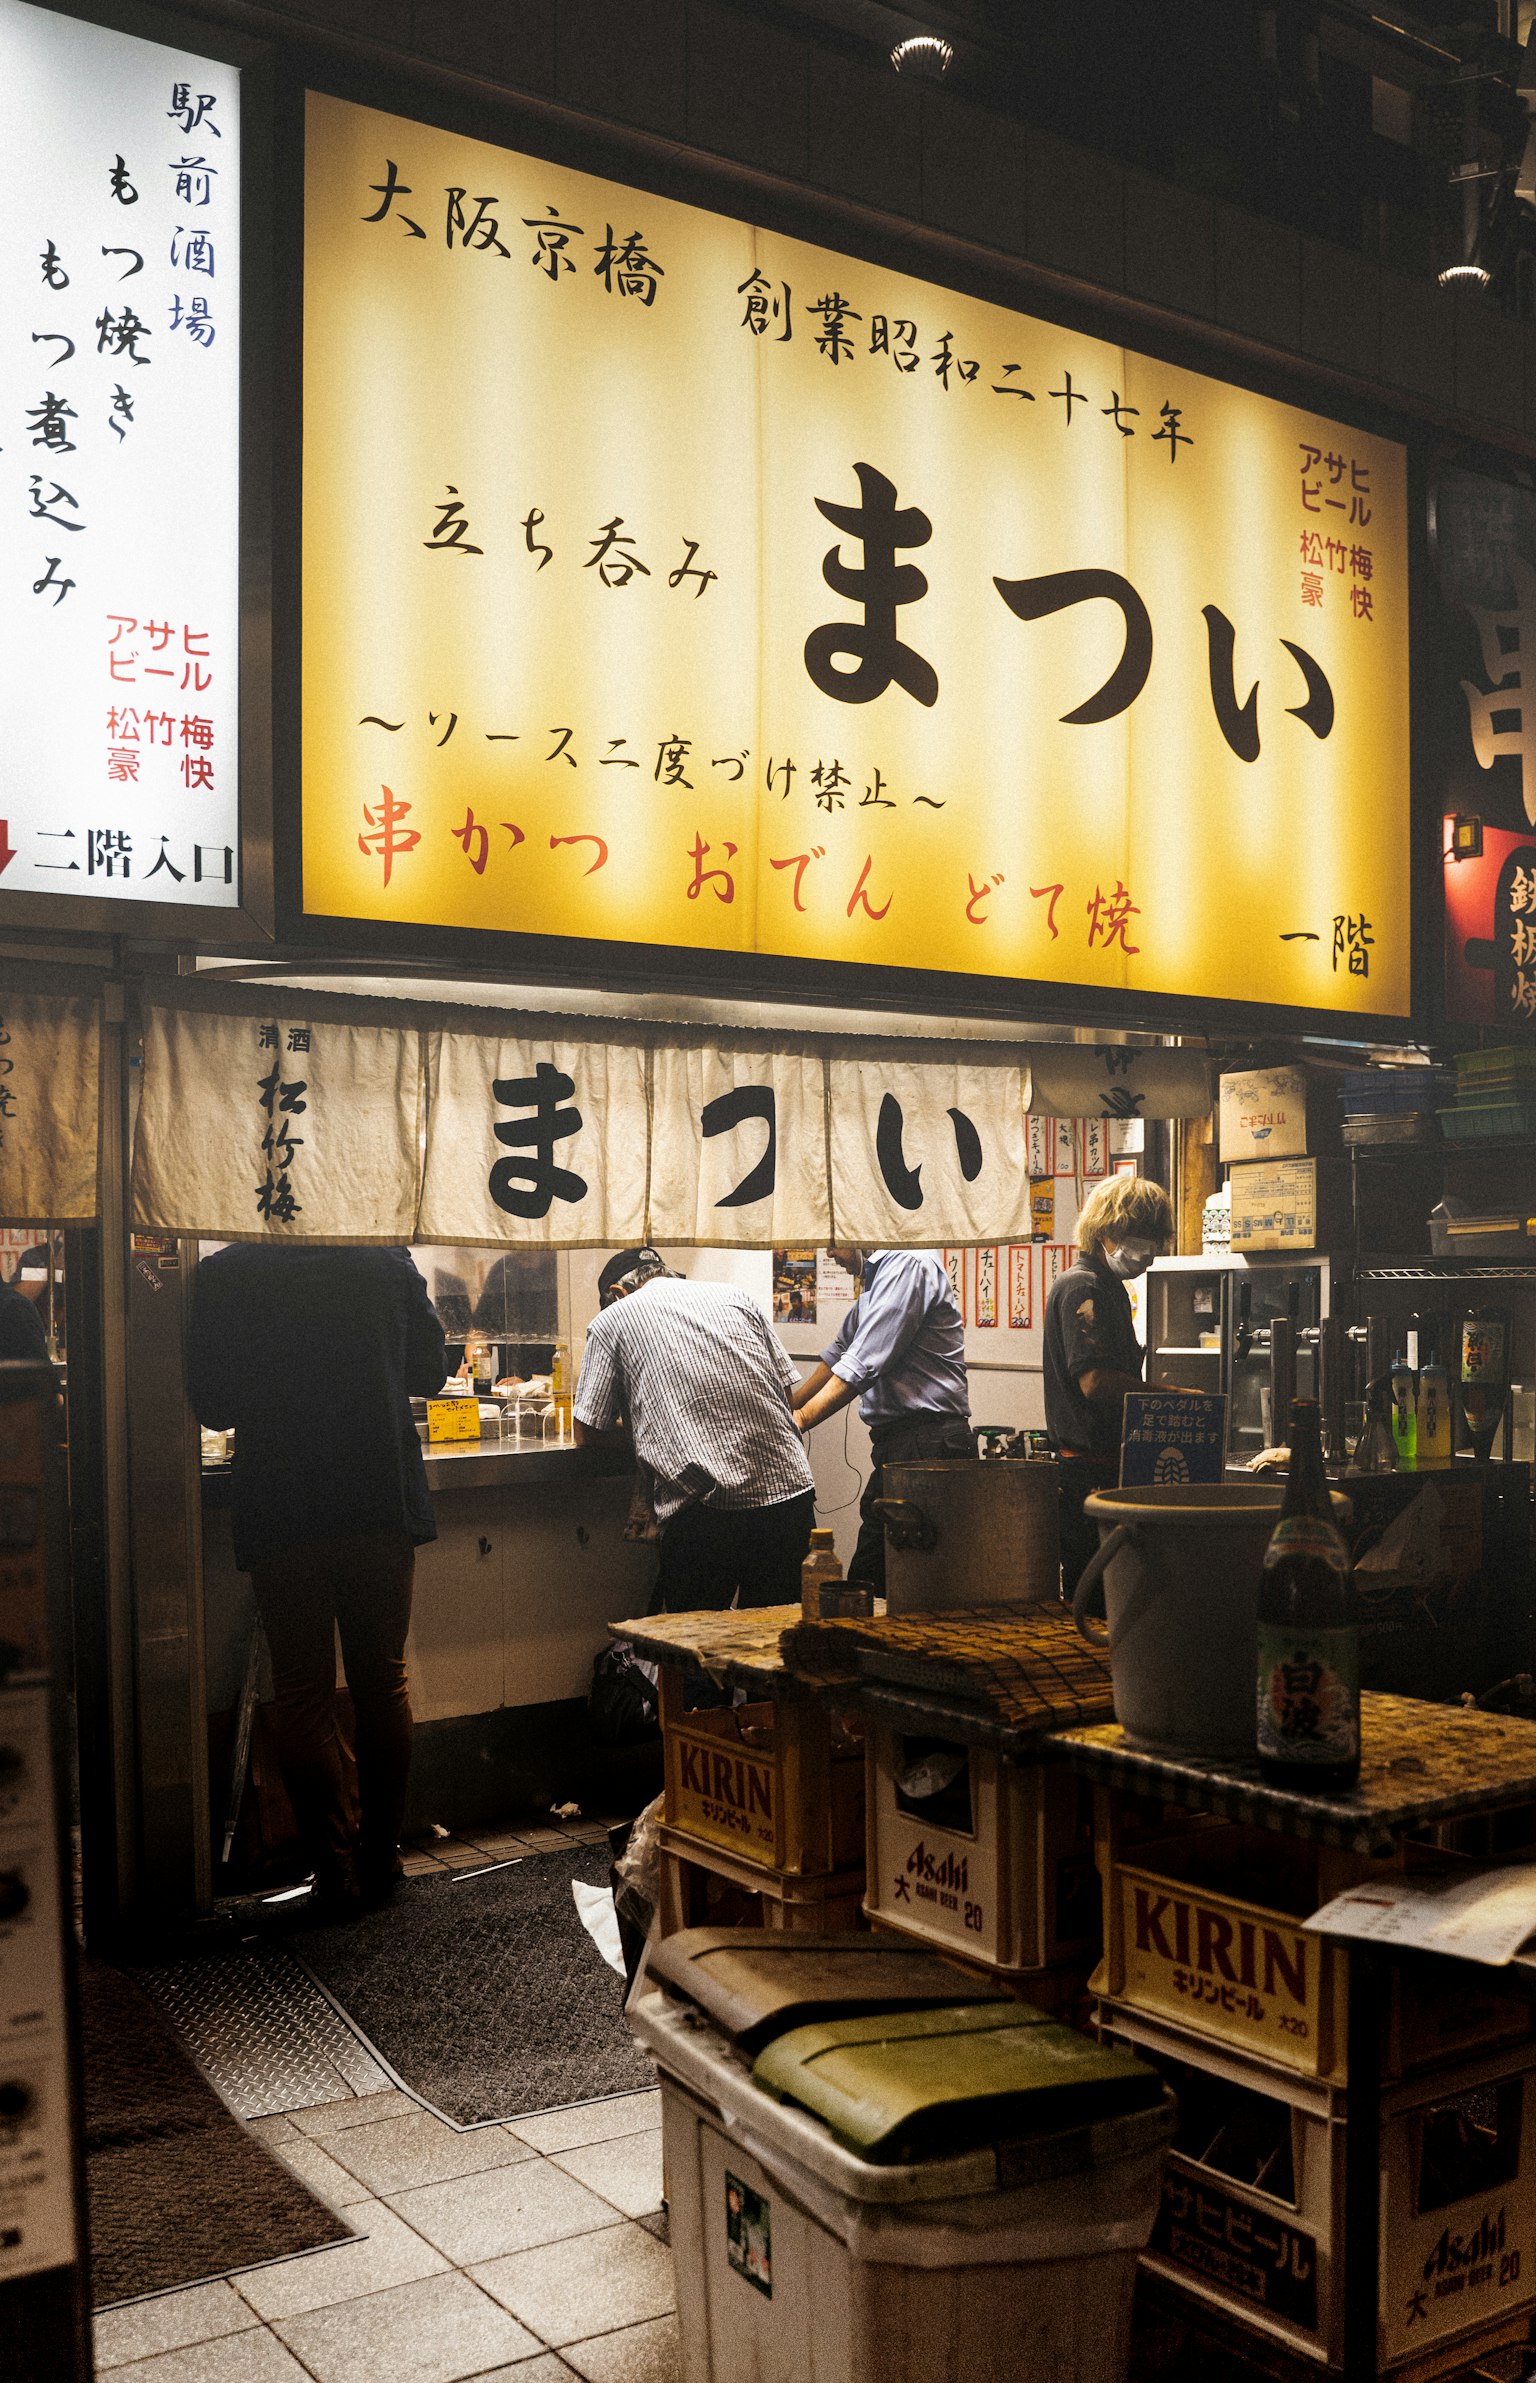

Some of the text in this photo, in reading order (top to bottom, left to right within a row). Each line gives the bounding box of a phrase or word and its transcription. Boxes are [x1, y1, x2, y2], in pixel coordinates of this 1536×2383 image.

[167, 83, 221, 348] 駅前酒場
[96, 154, 152, 443] もつ焼き
[360, 158, 1194, 464] 大阪京橋 創業昭和二十七年
[25, 239, 86, 607] もつ煮込み
[1299, 443, 1370, 493] アサヒ
[1302, 479, 1371, 527] ビール
[423, 485, 718, 600] 立ち呑み
[1300, 530, 1374, 581] 松竹梅
[804, 461, 1335, 763] まつい
[1301, 571, 1374, 623] 豪快
[106, 615, 211, 656] アサヒ
[109, 651, 212, 691] ビール
[106, 706, 214, 750] 松竹梅
[107, 747, 214, 790] 豪快
[34, 829, 234, 885] 二階入口
[358, 783, 1142, 958] 串かつ おでん どて焼
[1279, 912, 1375, 979] 一階
[258, 1024, 312, 1054] 清酒
[254, 1060, 308, 1223] 松竹梅
[488, 1062, 983, 1219] まつい
[980, 1248, 994, 1298] チューハイ
[1014, 1251, 1026, 1318] トマトチューハイ
[1128, 1429, 1219, 1444] 消毒液が出ます
[1142, 1414, 1206, 1428] 足で踏むと
[680, 1741, 772, 1820] KIRIN
[702, 1800, 751, 1833] キリンビール
[906, 1841, 968, 1893] Asahi
[894, 1875, 910, 1903] 大
[964, 1901, 982, 1932] 20
[1133, 1887, 1309, 2006] KIRIN
[1172, 1969, 1265, 2022] キリンビール
[1423, 2205, 1506, 2279] Asahi
[1405, 2290, 1427, 2326] 大
[1499, 2249, 1520, 2286] 20
